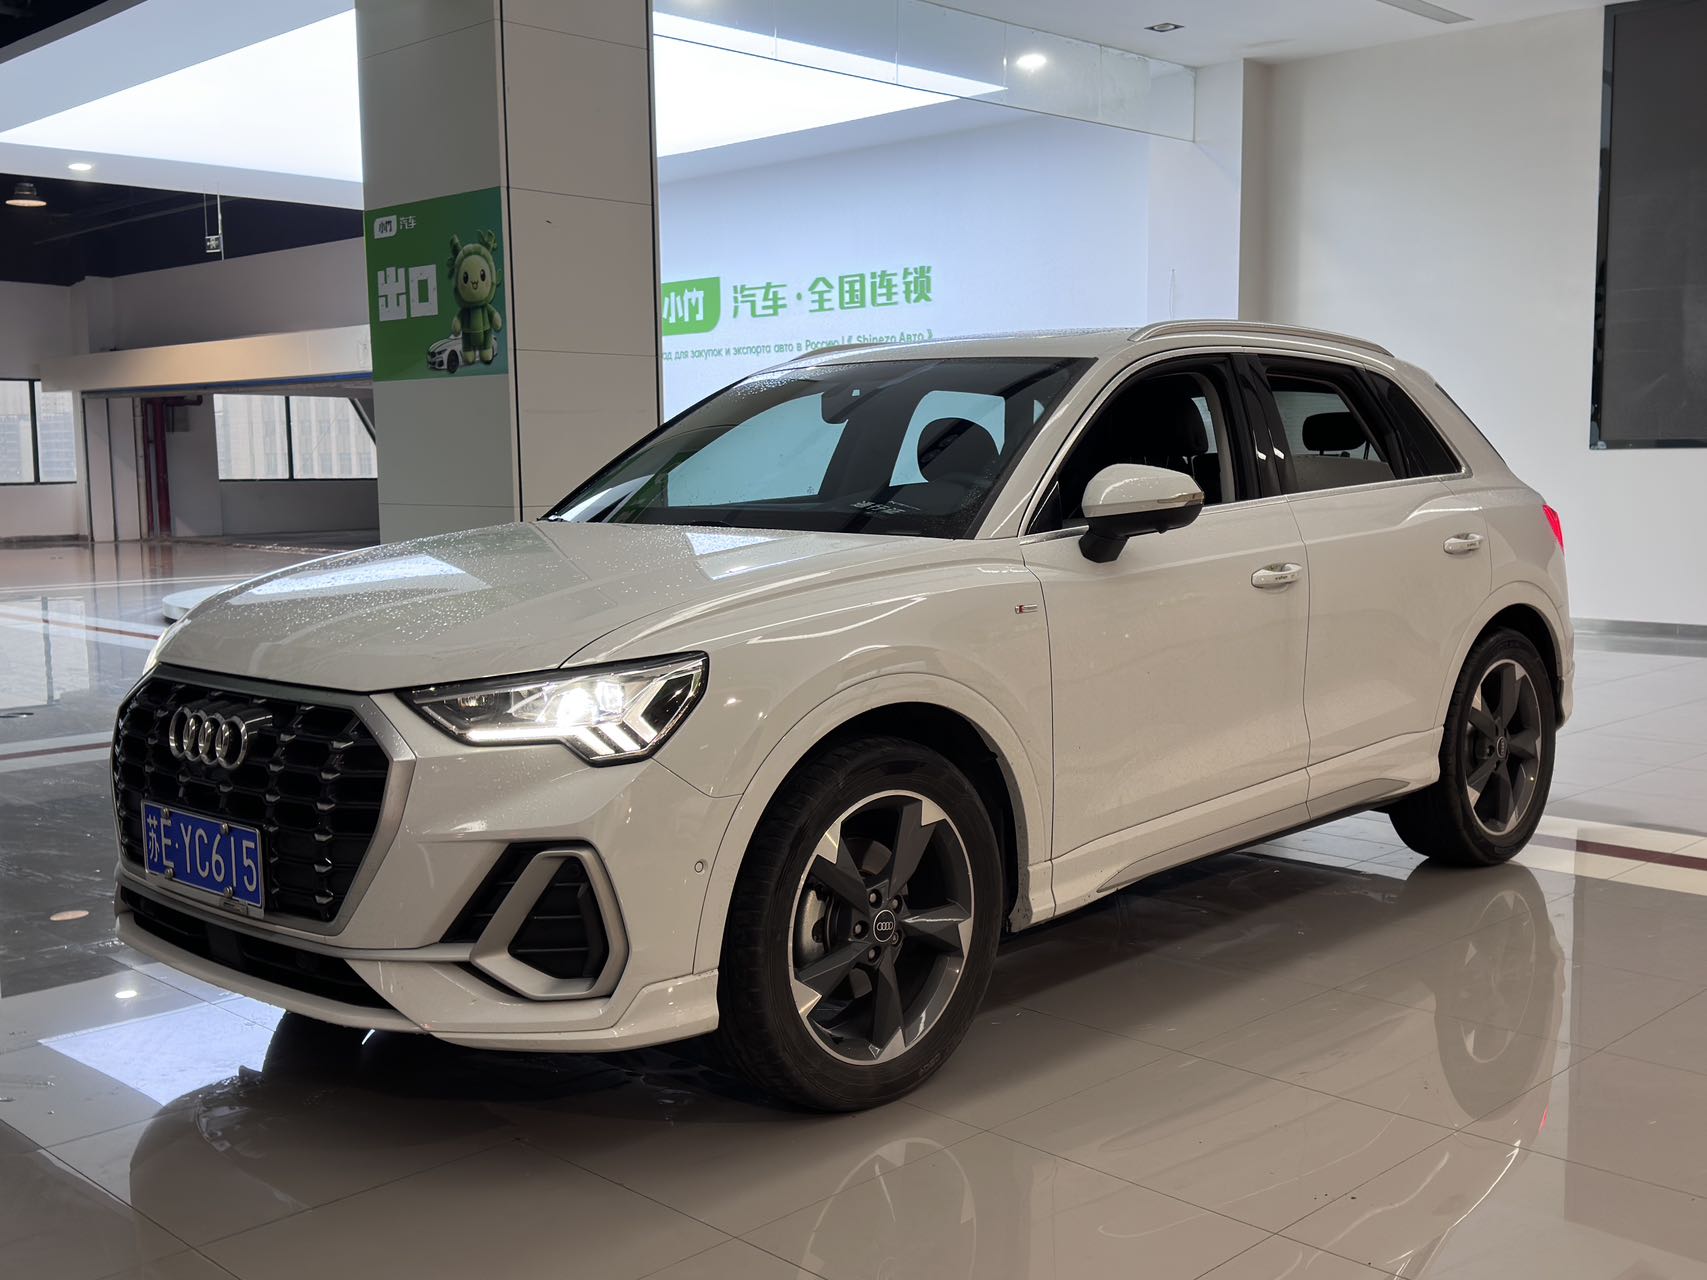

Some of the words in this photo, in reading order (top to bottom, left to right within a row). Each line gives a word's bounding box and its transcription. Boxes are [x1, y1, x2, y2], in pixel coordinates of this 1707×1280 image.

[377, 264, 439, 322] 出口
[663, 288, 704, 323] 小竹
[674, 350, 688, 360] для
[691, 347, 723, 360] закупок
[725, 347, 731, 356] и
[733, 344, 771, 358] экспорта
[774, 342, 793, 352] авто
[796, 342, 802, 352] в
[147, 814, 257, 892] 苏E·YC615
